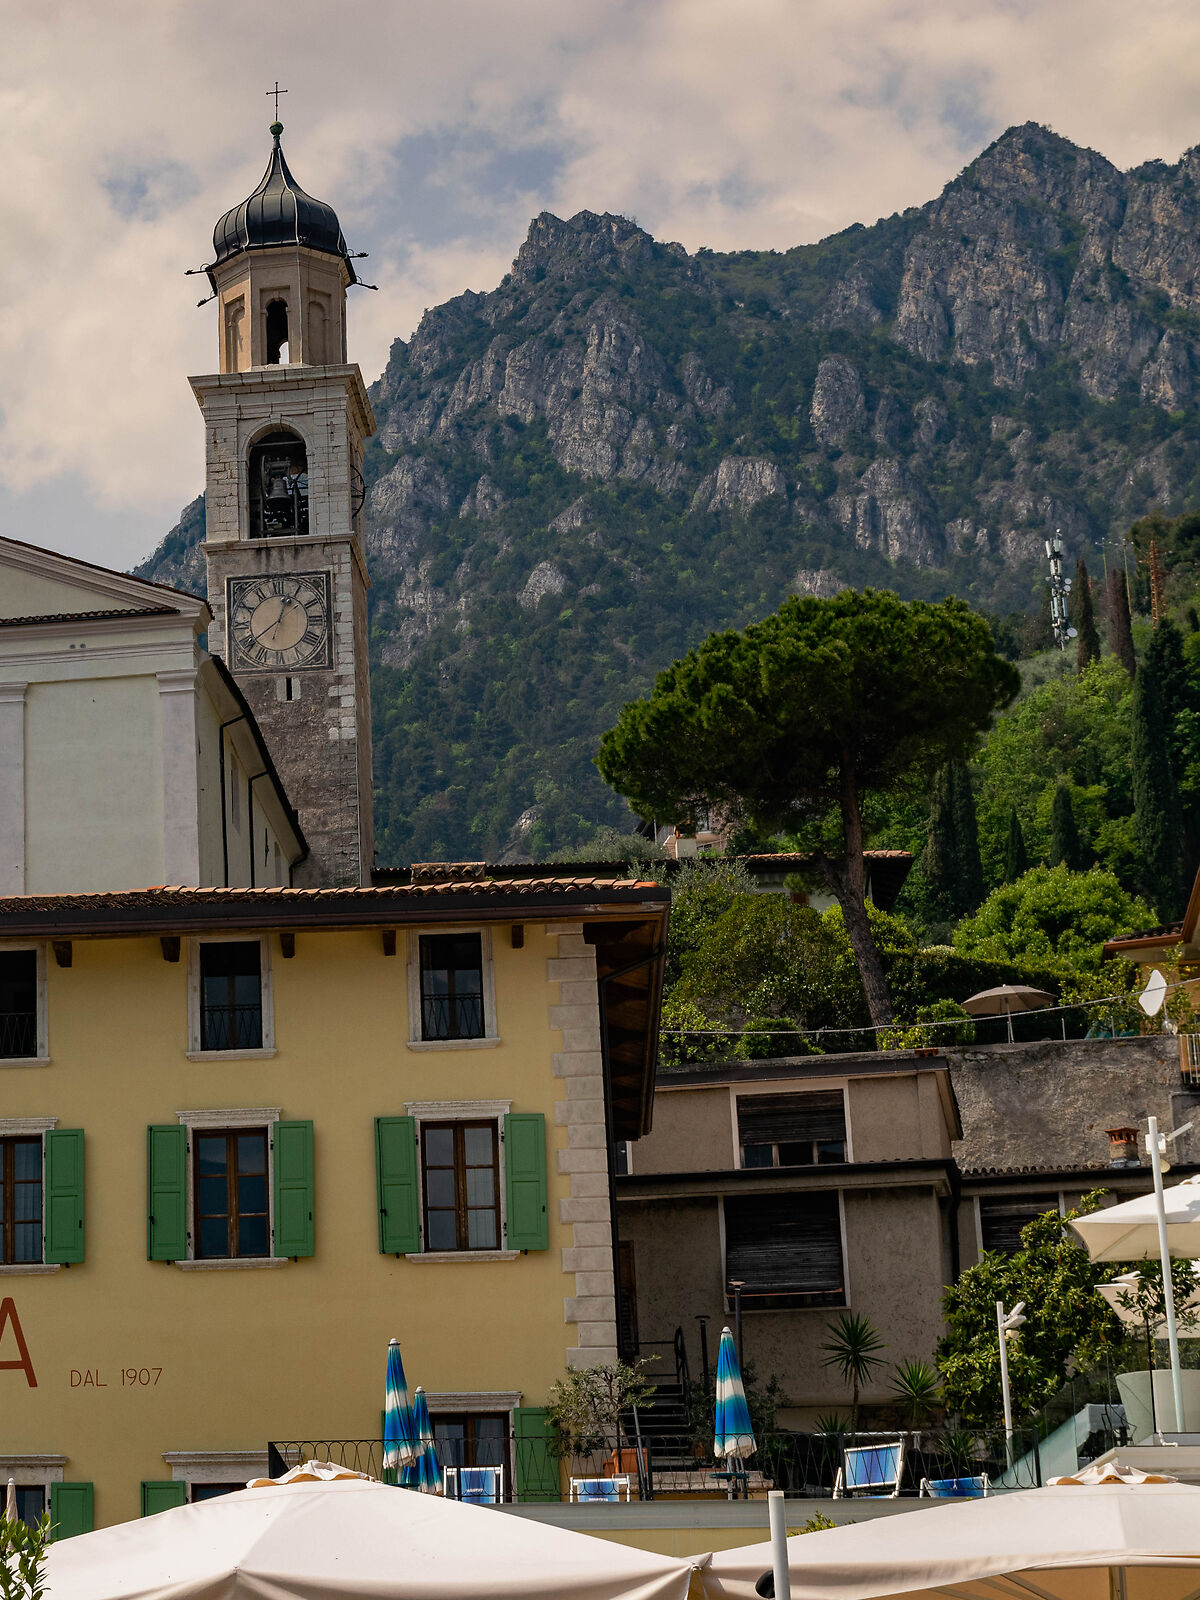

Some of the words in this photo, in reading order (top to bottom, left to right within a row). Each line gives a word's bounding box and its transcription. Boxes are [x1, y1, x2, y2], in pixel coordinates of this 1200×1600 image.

[294, 584, 302, 598] I
[239, 601, 255, 613] X
[304, 598, 319, 609] II
[234, 620, 250, 630] IX
[308, 615, 323, 626] III
[301, 630, 320, 646] IIII
[255, 647, 268, 662] VII
[294, 647, 305, 660] V
[70, 1369, 108, 1388] DAL
[121, 1367, 163, 1386] 1907
